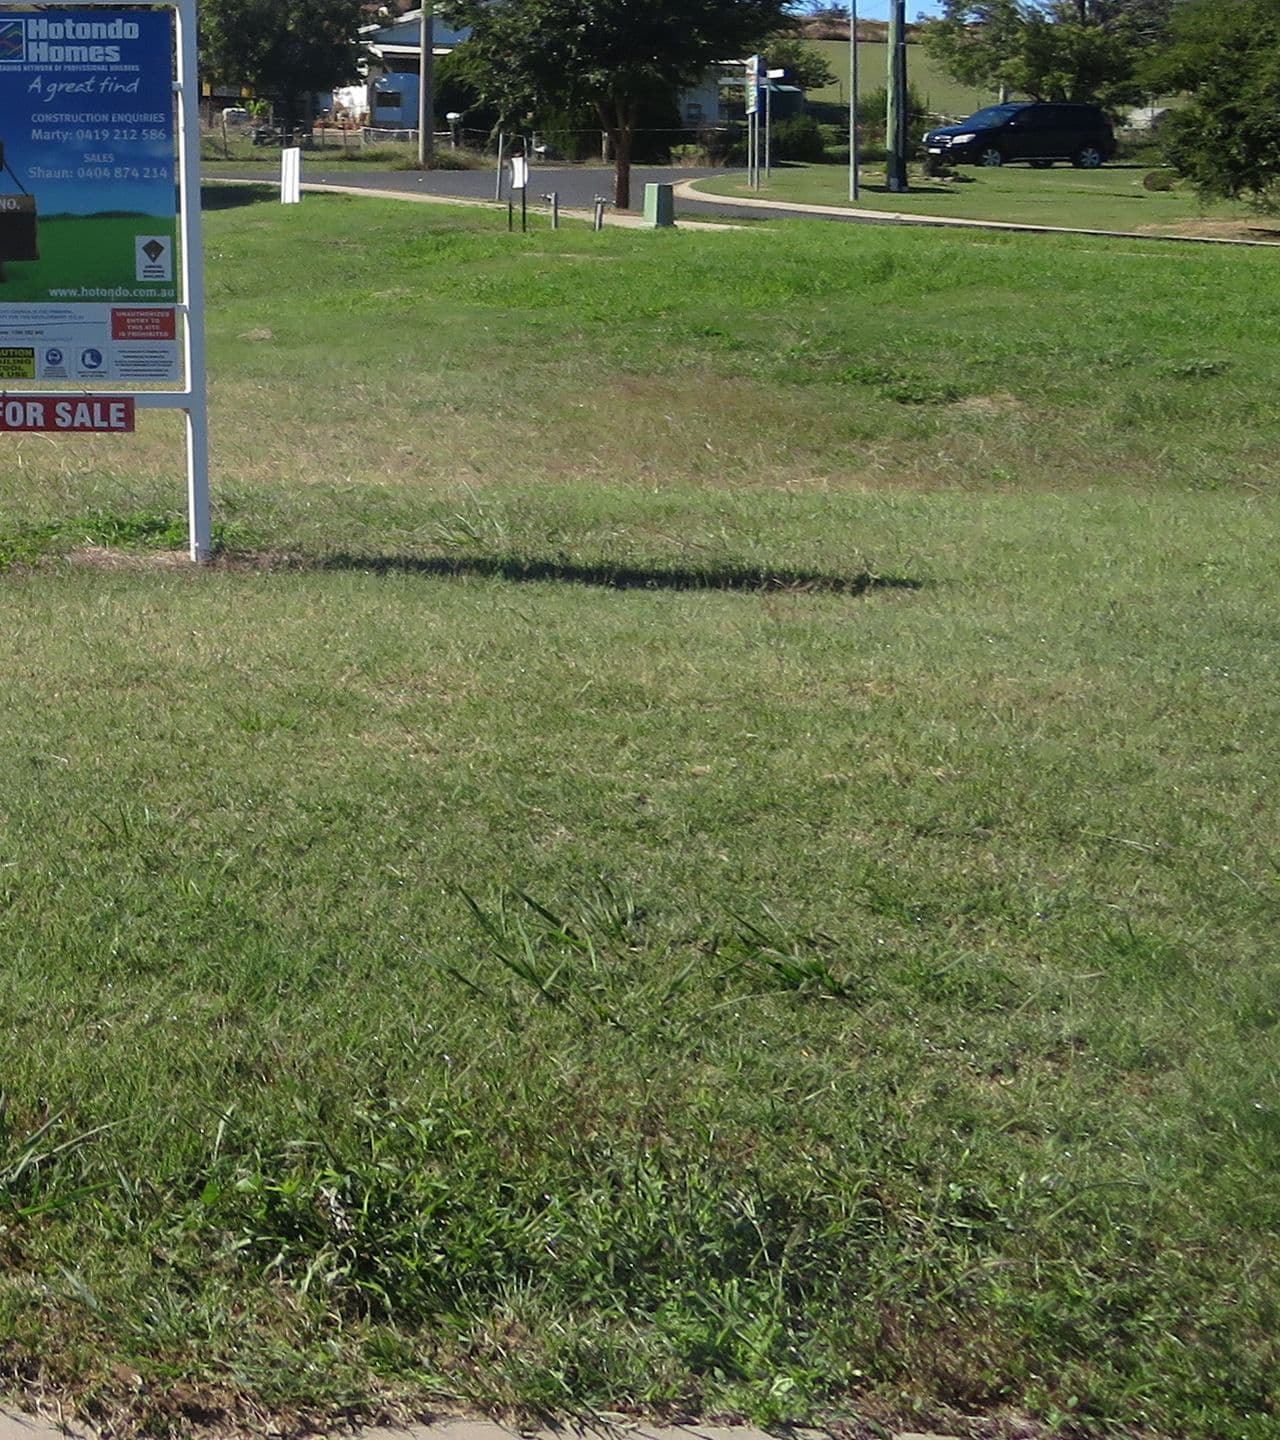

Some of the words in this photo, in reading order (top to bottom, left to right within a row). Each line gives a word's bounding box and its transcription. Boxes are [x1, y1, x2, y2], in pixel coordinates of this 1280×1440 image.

[28, 18, 139, 39] Hotondo
[28, 42, 120, 62] Homes
[27, 75, 42, 93] A
[43, 76, 95, 102] great
[99, 77, 140, 93] find
[31, 113, 109, 123] CONSTRUCTION
[111, 113, 165, 124] ENQUIRIES
[31, 128, 72, 143] Marty:
[76, 129, 109, 141] 0419
[113, 129, 138, 141] 212
[141, 129, 166, 141] 586
[83, 153, 114, 163] SALES
[28, 166, 73, 179] Shaun:
[114, 167, 139, 179] 874
[143, 167, 168, 179] 214
[49, 287, 176, 298] www.hotondo.com.au
[55, 401, 126, 429] SALE
